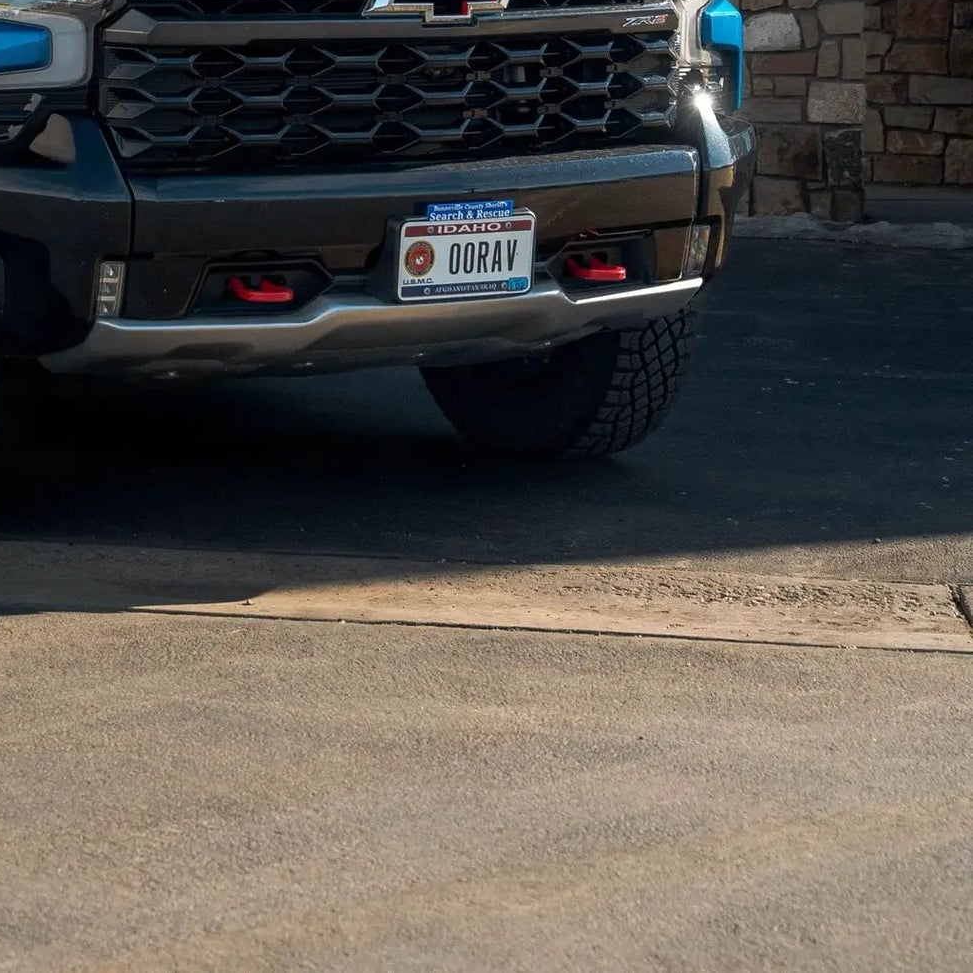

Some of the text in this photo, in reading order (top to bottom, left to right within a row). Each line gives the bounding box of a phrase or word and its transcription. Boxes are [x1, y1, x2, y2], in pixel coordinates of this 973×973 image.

[464, 203, 484, 211] County
[429, 209, 510, 221] Search & Rescue
[437, 222, 502, 234] IDAHO
